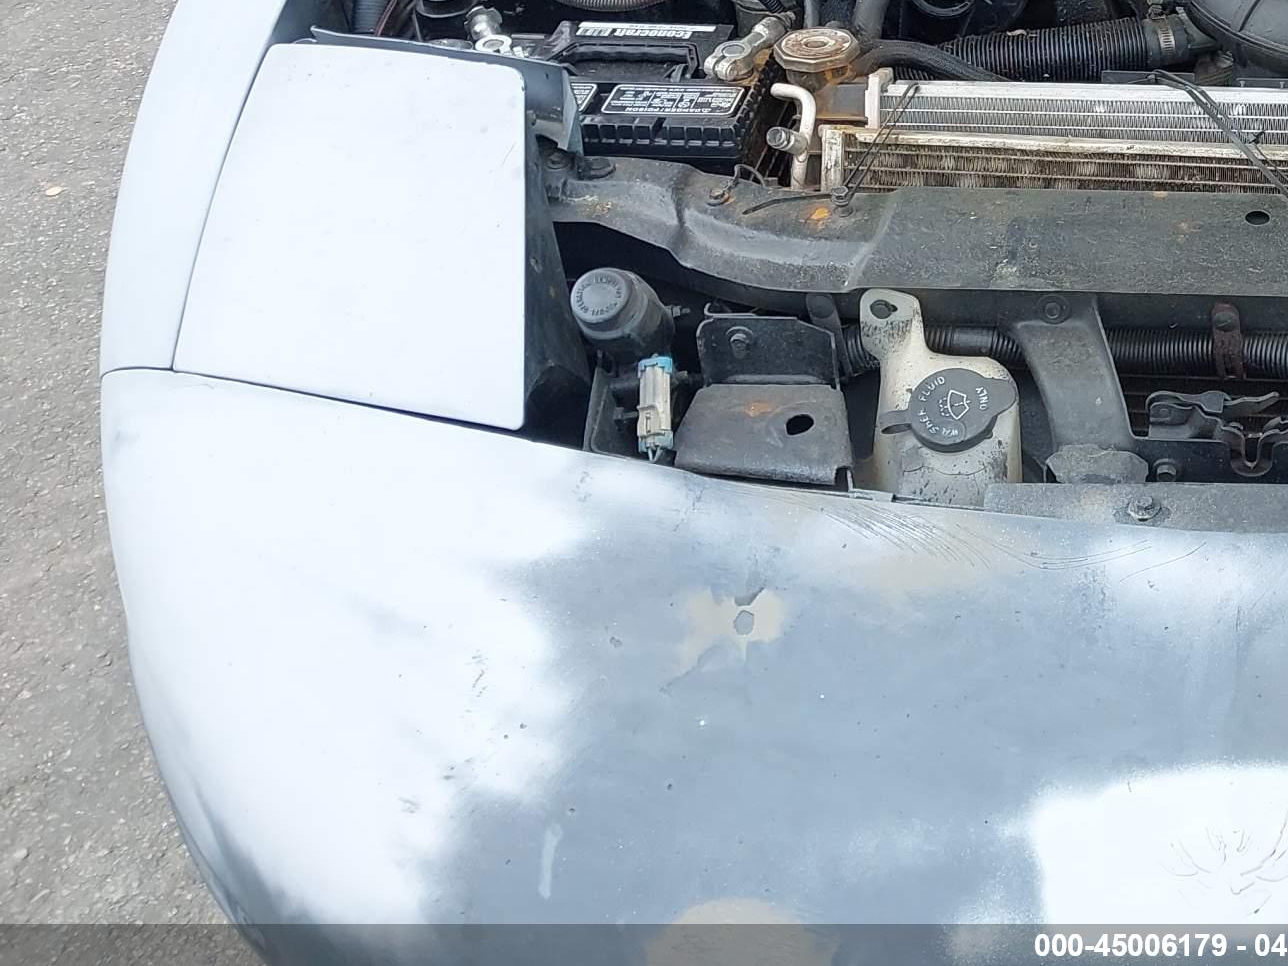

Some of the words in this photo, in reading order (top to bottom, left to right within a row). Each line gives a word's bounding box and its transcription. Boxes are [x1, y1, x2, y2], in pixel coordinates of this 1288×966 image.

[613, 28, 693, 39] Econocraft
[918, 376, 945, 402] FLUID
[975, 386, 989, 410] ONLY
